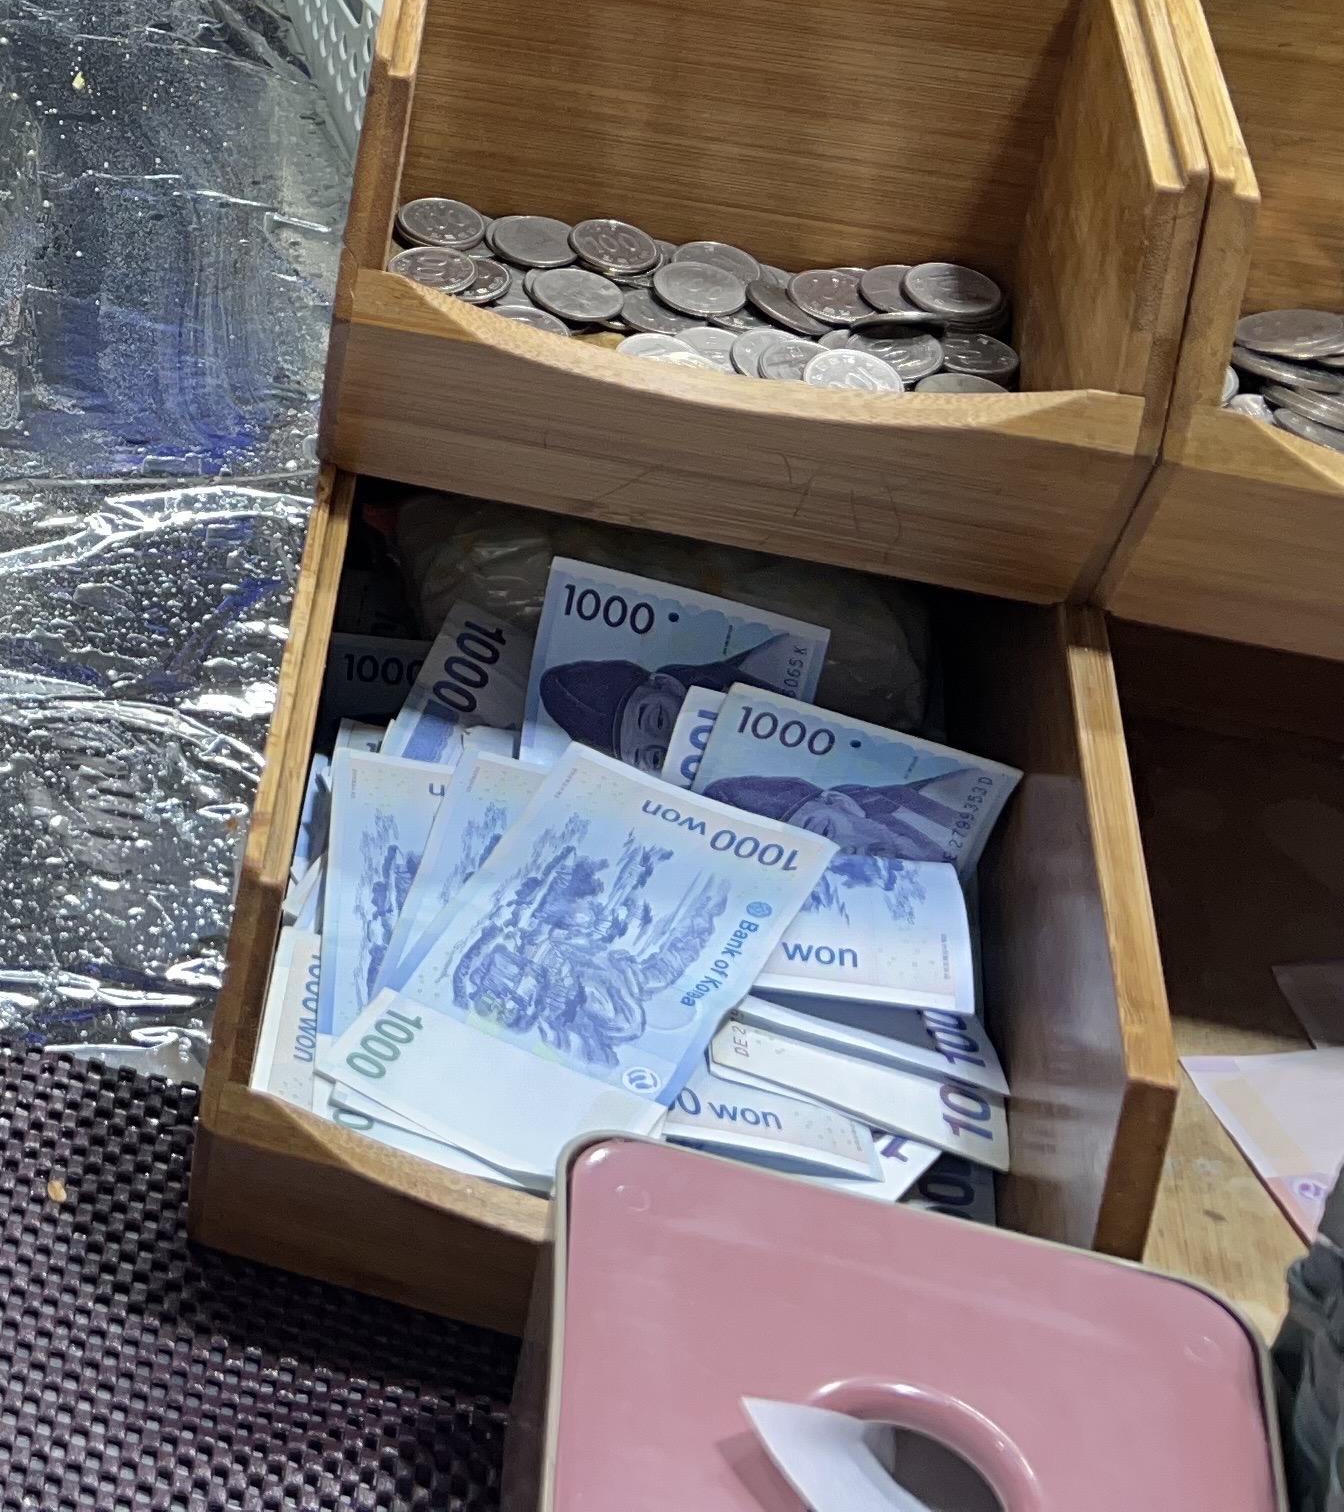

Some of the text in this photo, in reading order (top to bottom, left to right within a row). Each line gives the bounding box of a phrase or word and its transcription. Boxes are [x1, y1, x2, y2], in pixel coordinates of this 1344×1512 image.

[563, 583, 656, 636] 1000
[431, 619, 508, 714] 1000
[736, 704, 836, 757] 1000
[641, 799, 800, 871] 1000 won
[721, 918, 760, 961] Bank
[781, 941, 859, 969] won
[711, 958, 730, 980] of
[345, 1009, 424, 1080] 1000
[708, 1101, 783, 1130] won
